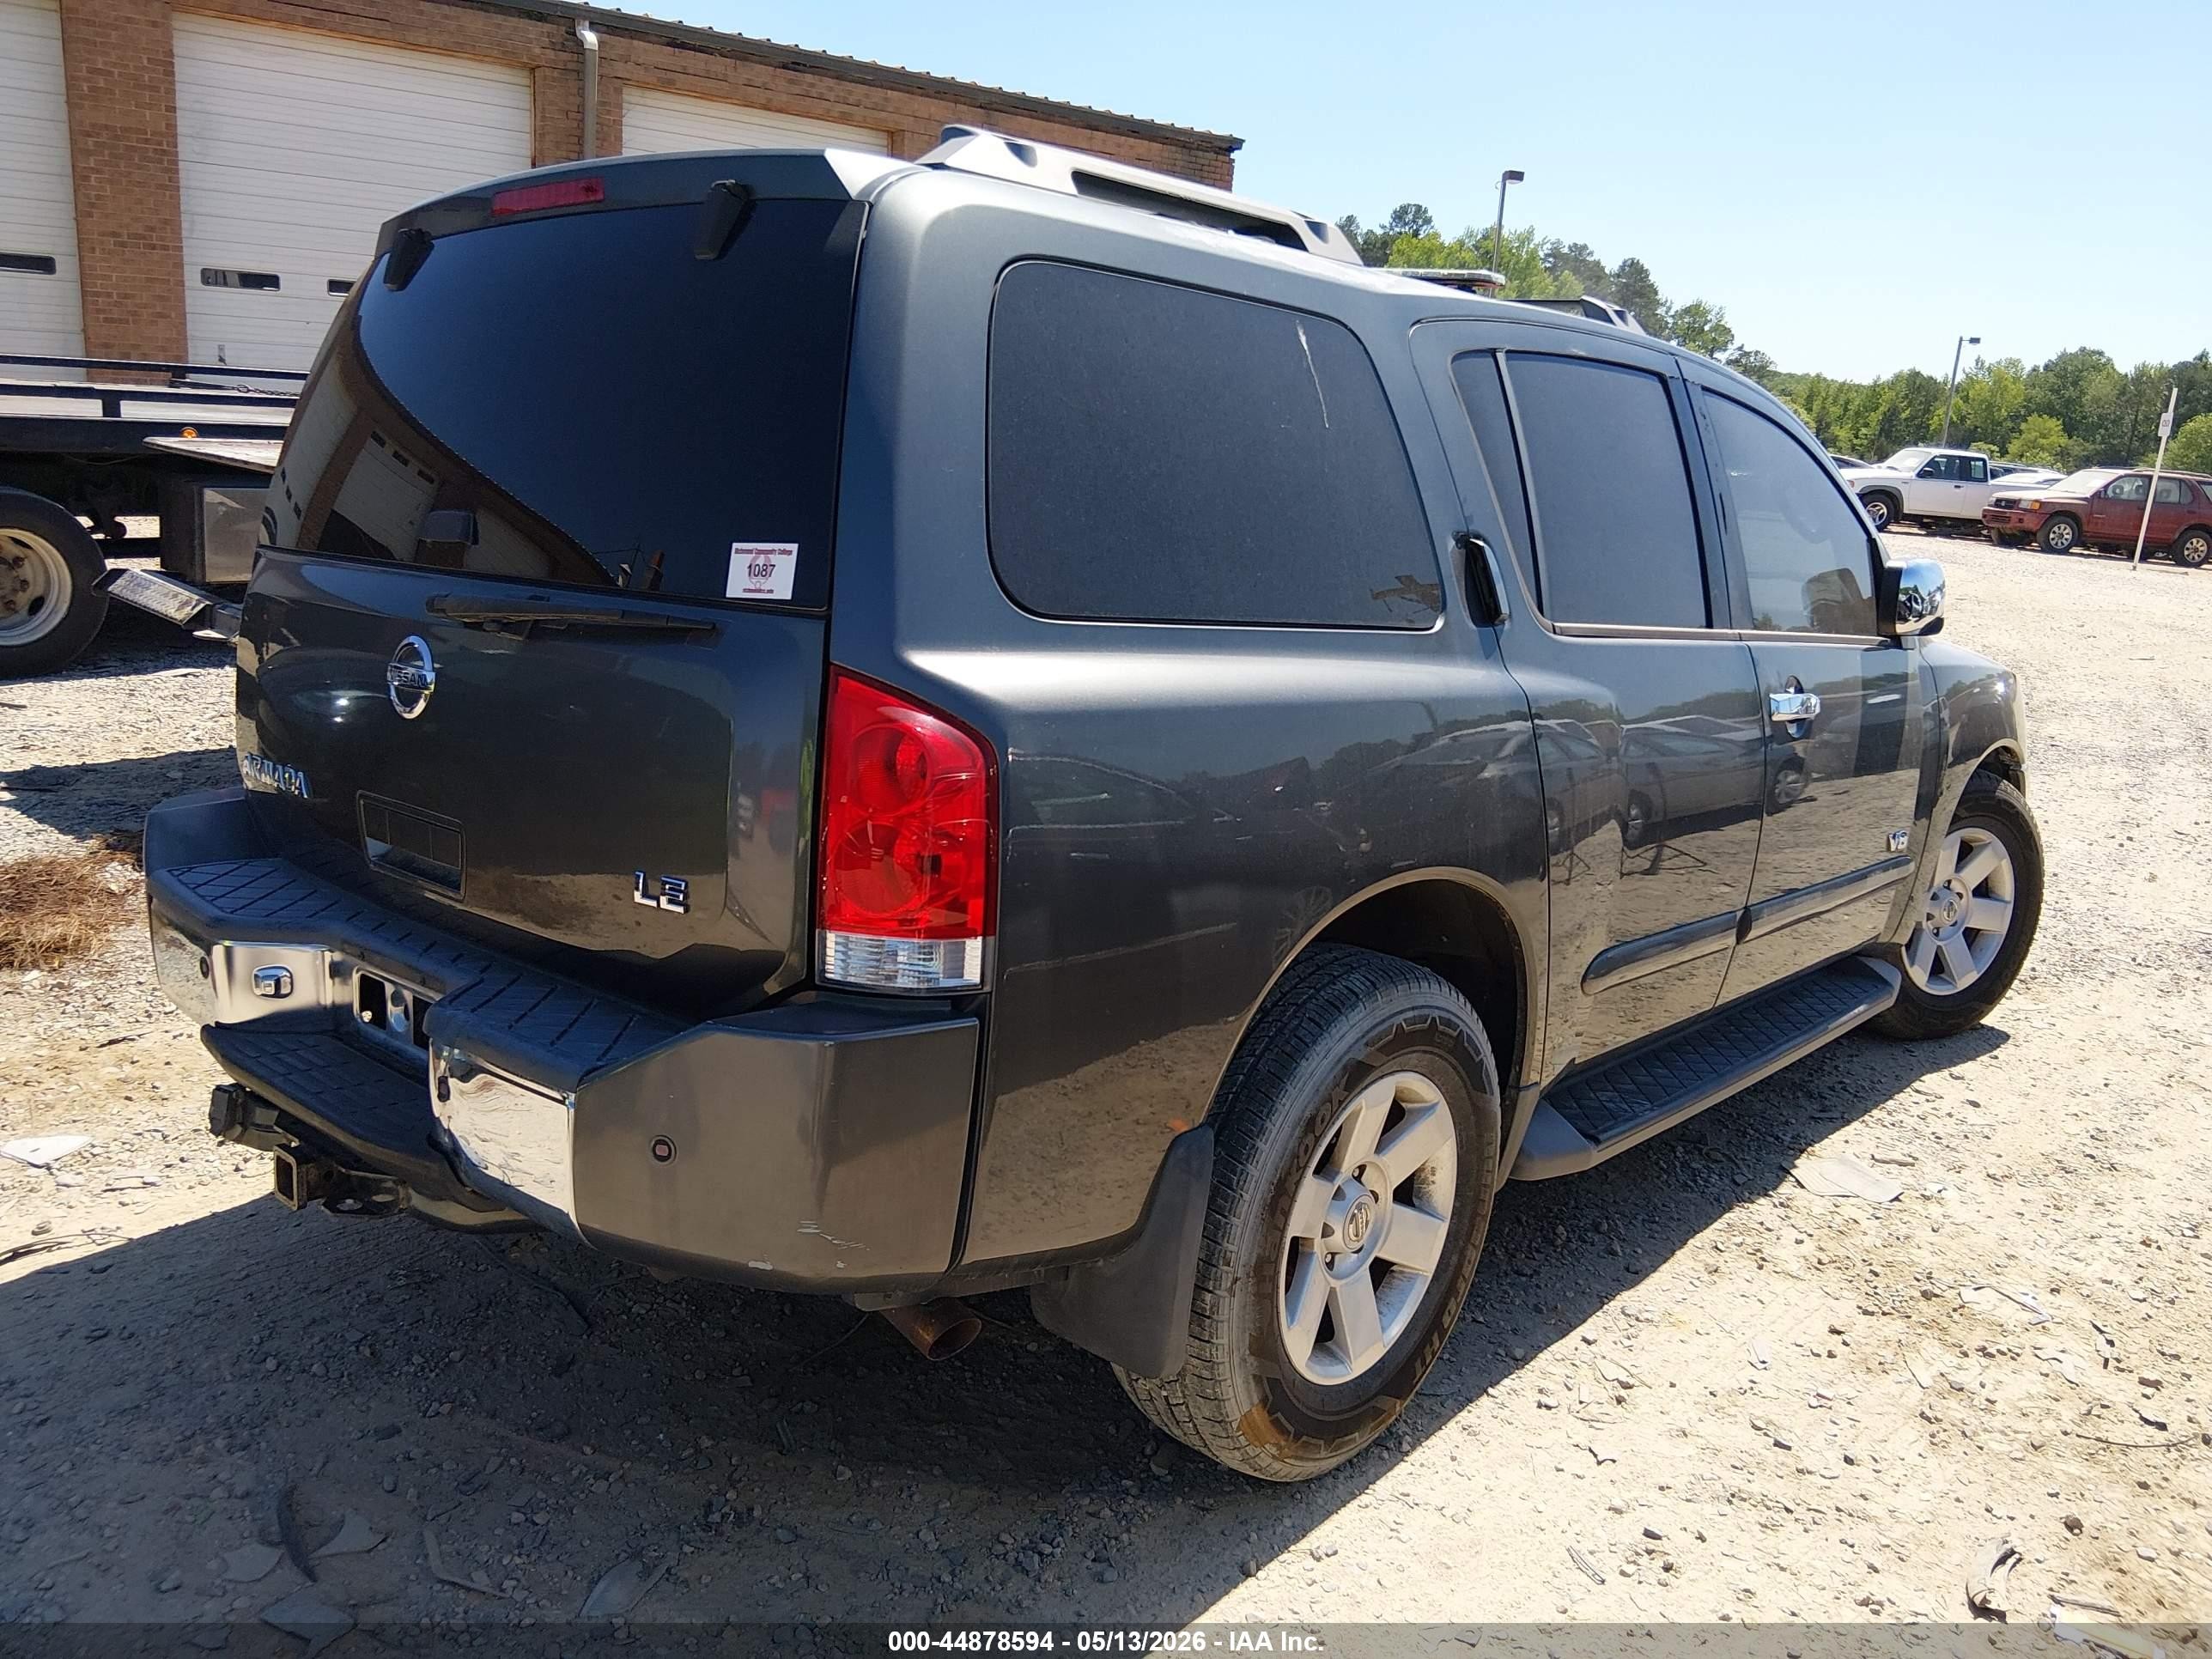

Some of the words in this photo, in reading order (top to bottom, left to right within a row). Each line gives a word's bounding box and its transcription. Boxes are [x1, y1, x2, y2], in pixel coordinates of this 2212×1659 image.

[747, 563, 776, 578] 1087
[242, 752, 308, 799] ARMADA
[1888, 830, 1910, 852] V8
[633, 871, 687, 915] LE
